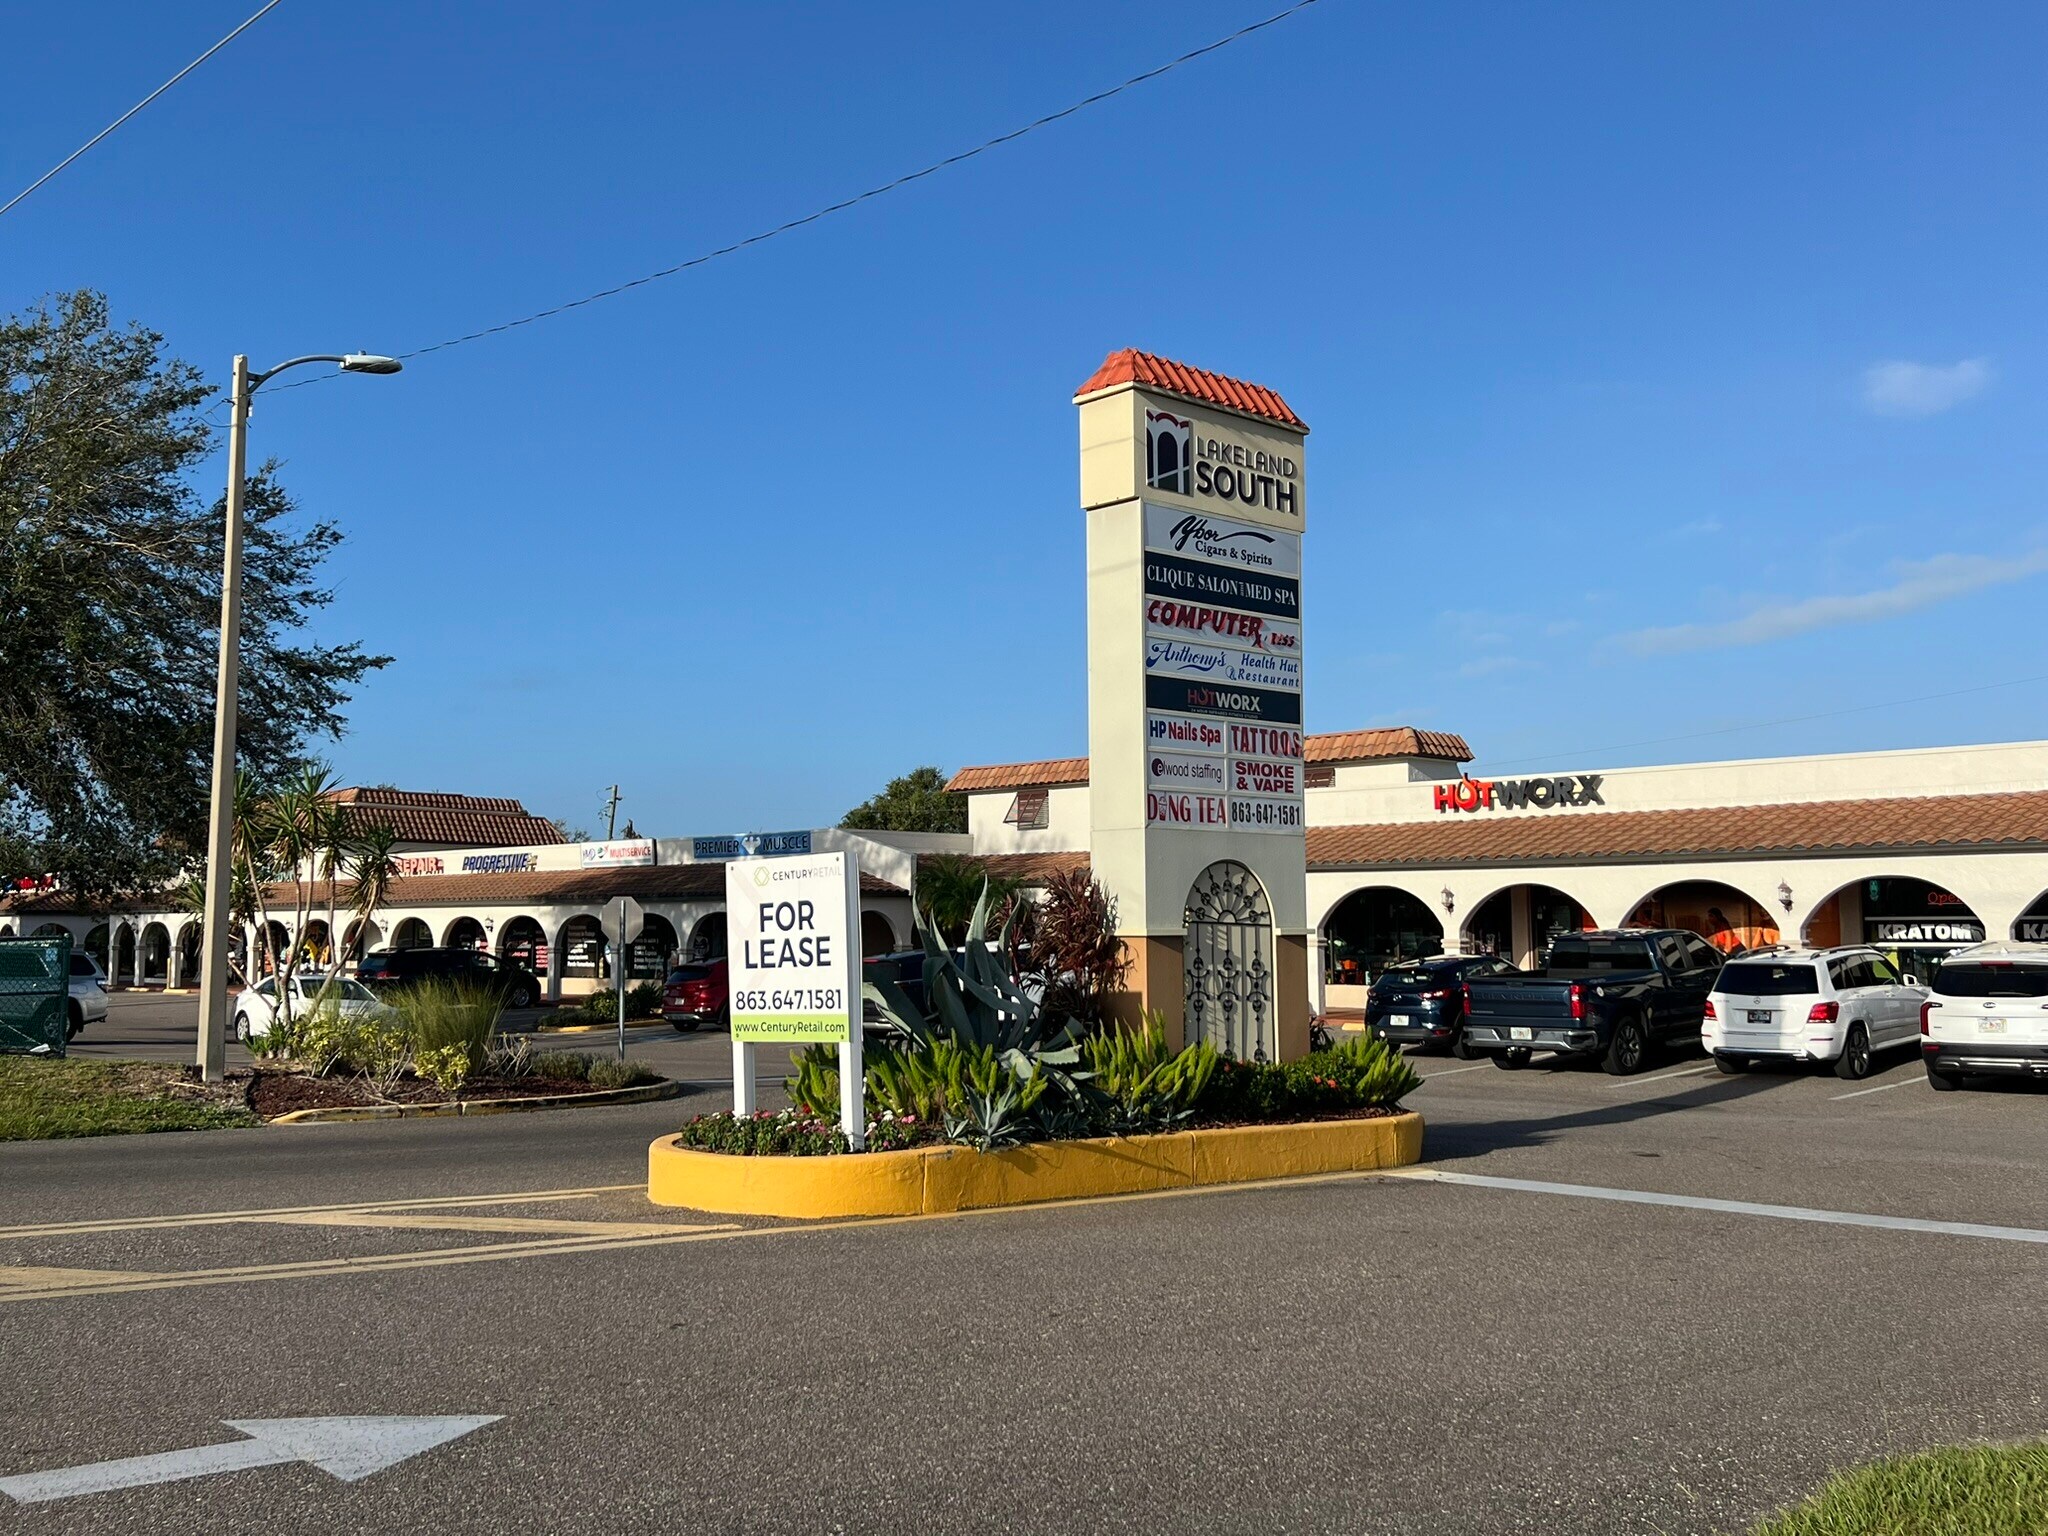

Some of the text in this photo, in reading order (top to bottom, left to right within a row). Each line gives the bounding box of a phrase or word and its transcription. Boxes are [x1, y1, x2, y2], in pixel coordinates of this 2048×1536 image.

[1195, 436, 1295, 477] LAKELAND
[1195, 461, 1295, 514] SOUTH
[1195, 540, 1273, 566] Cigars & Spirits
[1146, 564, 1195, 589] CLIQUE
[1198, 574, 1238, 596] SALON
[1245, 583, 1271, 601] MED
[1274, 588, 1296, 606] SPA
[1147, 600, 1264, 638] COMPUTER
[1146, 642, 1299, 674] Anthony's Health Hut
[1238, 668, 1300, 688] Restaurant
[1150, 720, 1221, 747] HP Nails Spa
[1231, 725, 1302, 758] TATTOOS
[1191, 763, 1222, 783] staffing
[1235, 761, 1294, 779] SMOKE
[1236, 777, 1294, 793] & VAPE
[1433, 773, 1605, 811] HOTWORX
[1196, 796, 1227, 825] TEA
[1231, 801, 1300, 826] 863-647-1581
[609, 846, 651, 858] MULTISERVICE
[695, 836, 809, 854] PREMIER MUSCLE
[462, 853, 529, 871] PROGRESSIVE
[759, 900, 815, 933] FOR
[1878, 923, 1972, 940] KRATOM
[744, 936, 832, 969] LEASE
[735, 989, 842, 1010] 863.647.1581
[734, 1021, 845, 1034] www.CenturyRetail.com
